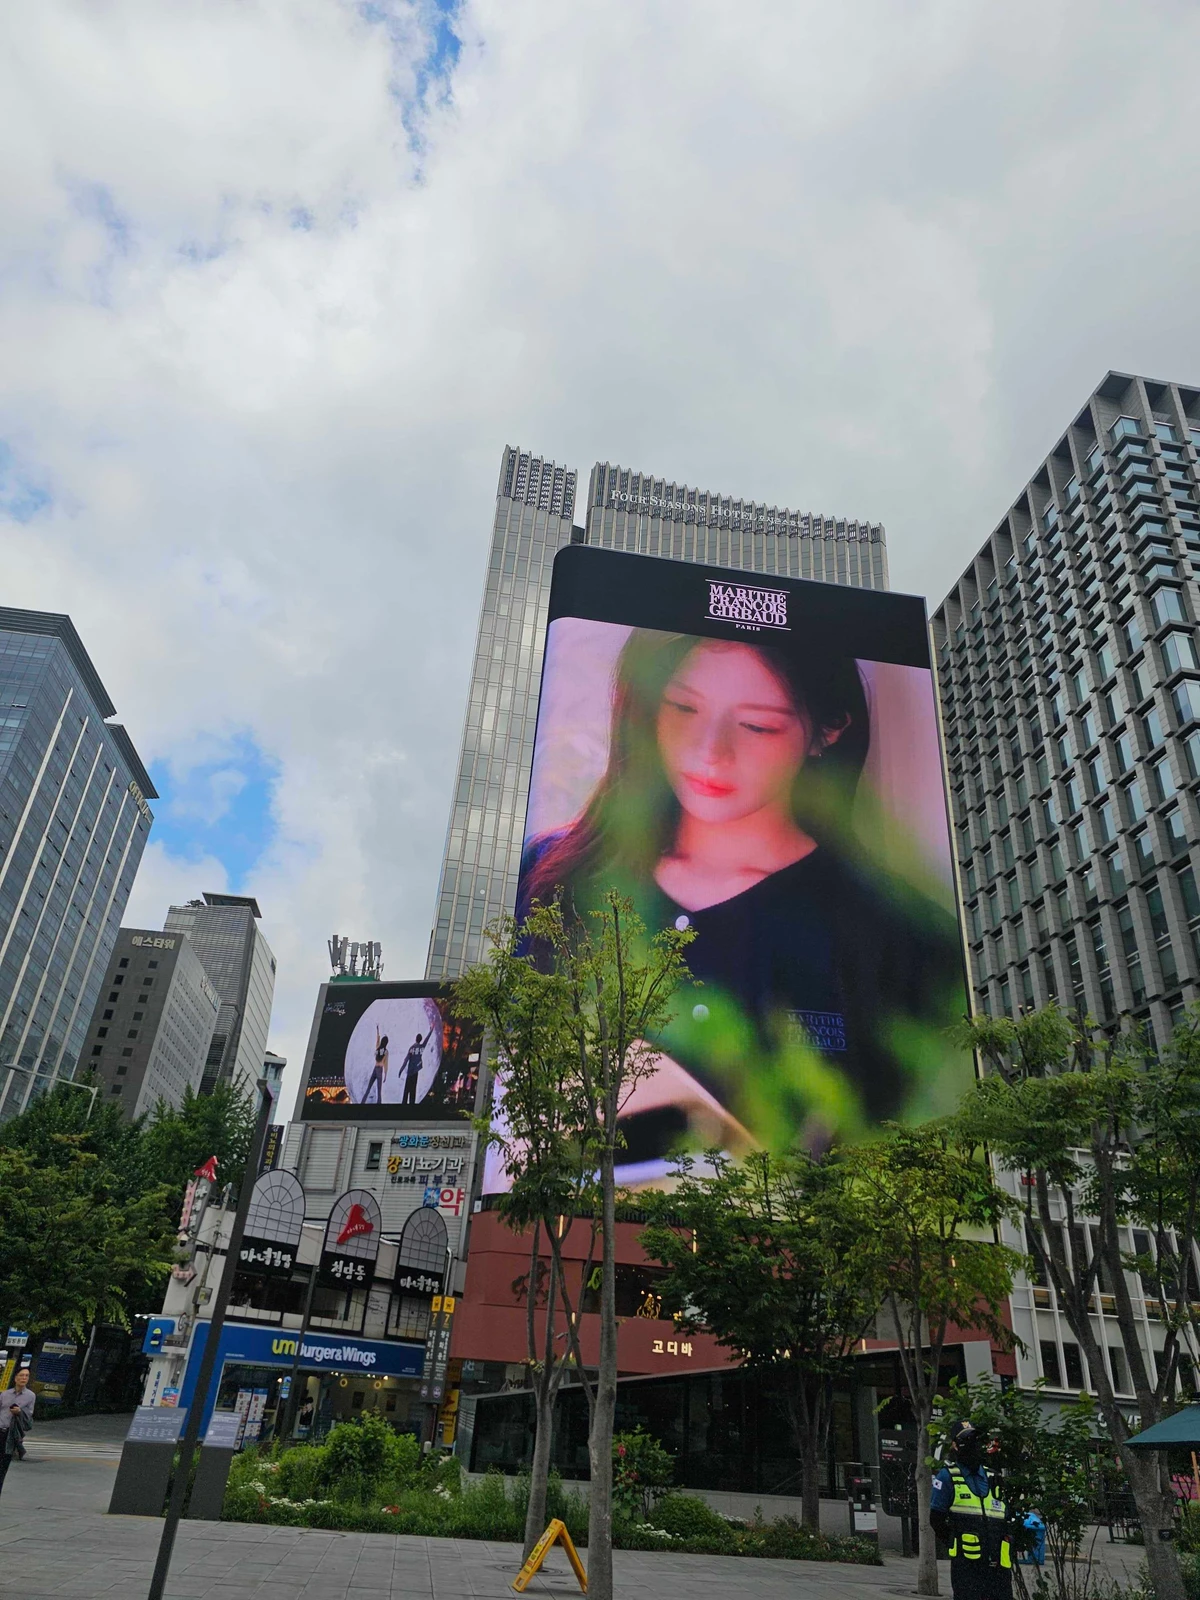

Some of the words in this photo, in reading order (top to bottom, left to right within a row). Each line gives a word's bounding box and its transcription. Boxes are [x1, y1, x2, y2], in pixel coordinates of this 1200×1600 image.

[610, 489, 647, 505] FOUR
[650, 495, 706, 514] SEASONS
[710, 504, 756, 521] HOTEL
[709, 604, 788, 626] GIRBAUD
[735, 623, 761, 632] PARIS
[131, 935, 176, 950] 에스타워
[387, 1155, 465, 1174] 강비뇨기과
[440, 1188, 465, 1216] 약
[330, 1260, 366, 1281] 청담동
[652, 1339, 693, 1357] 고디바
